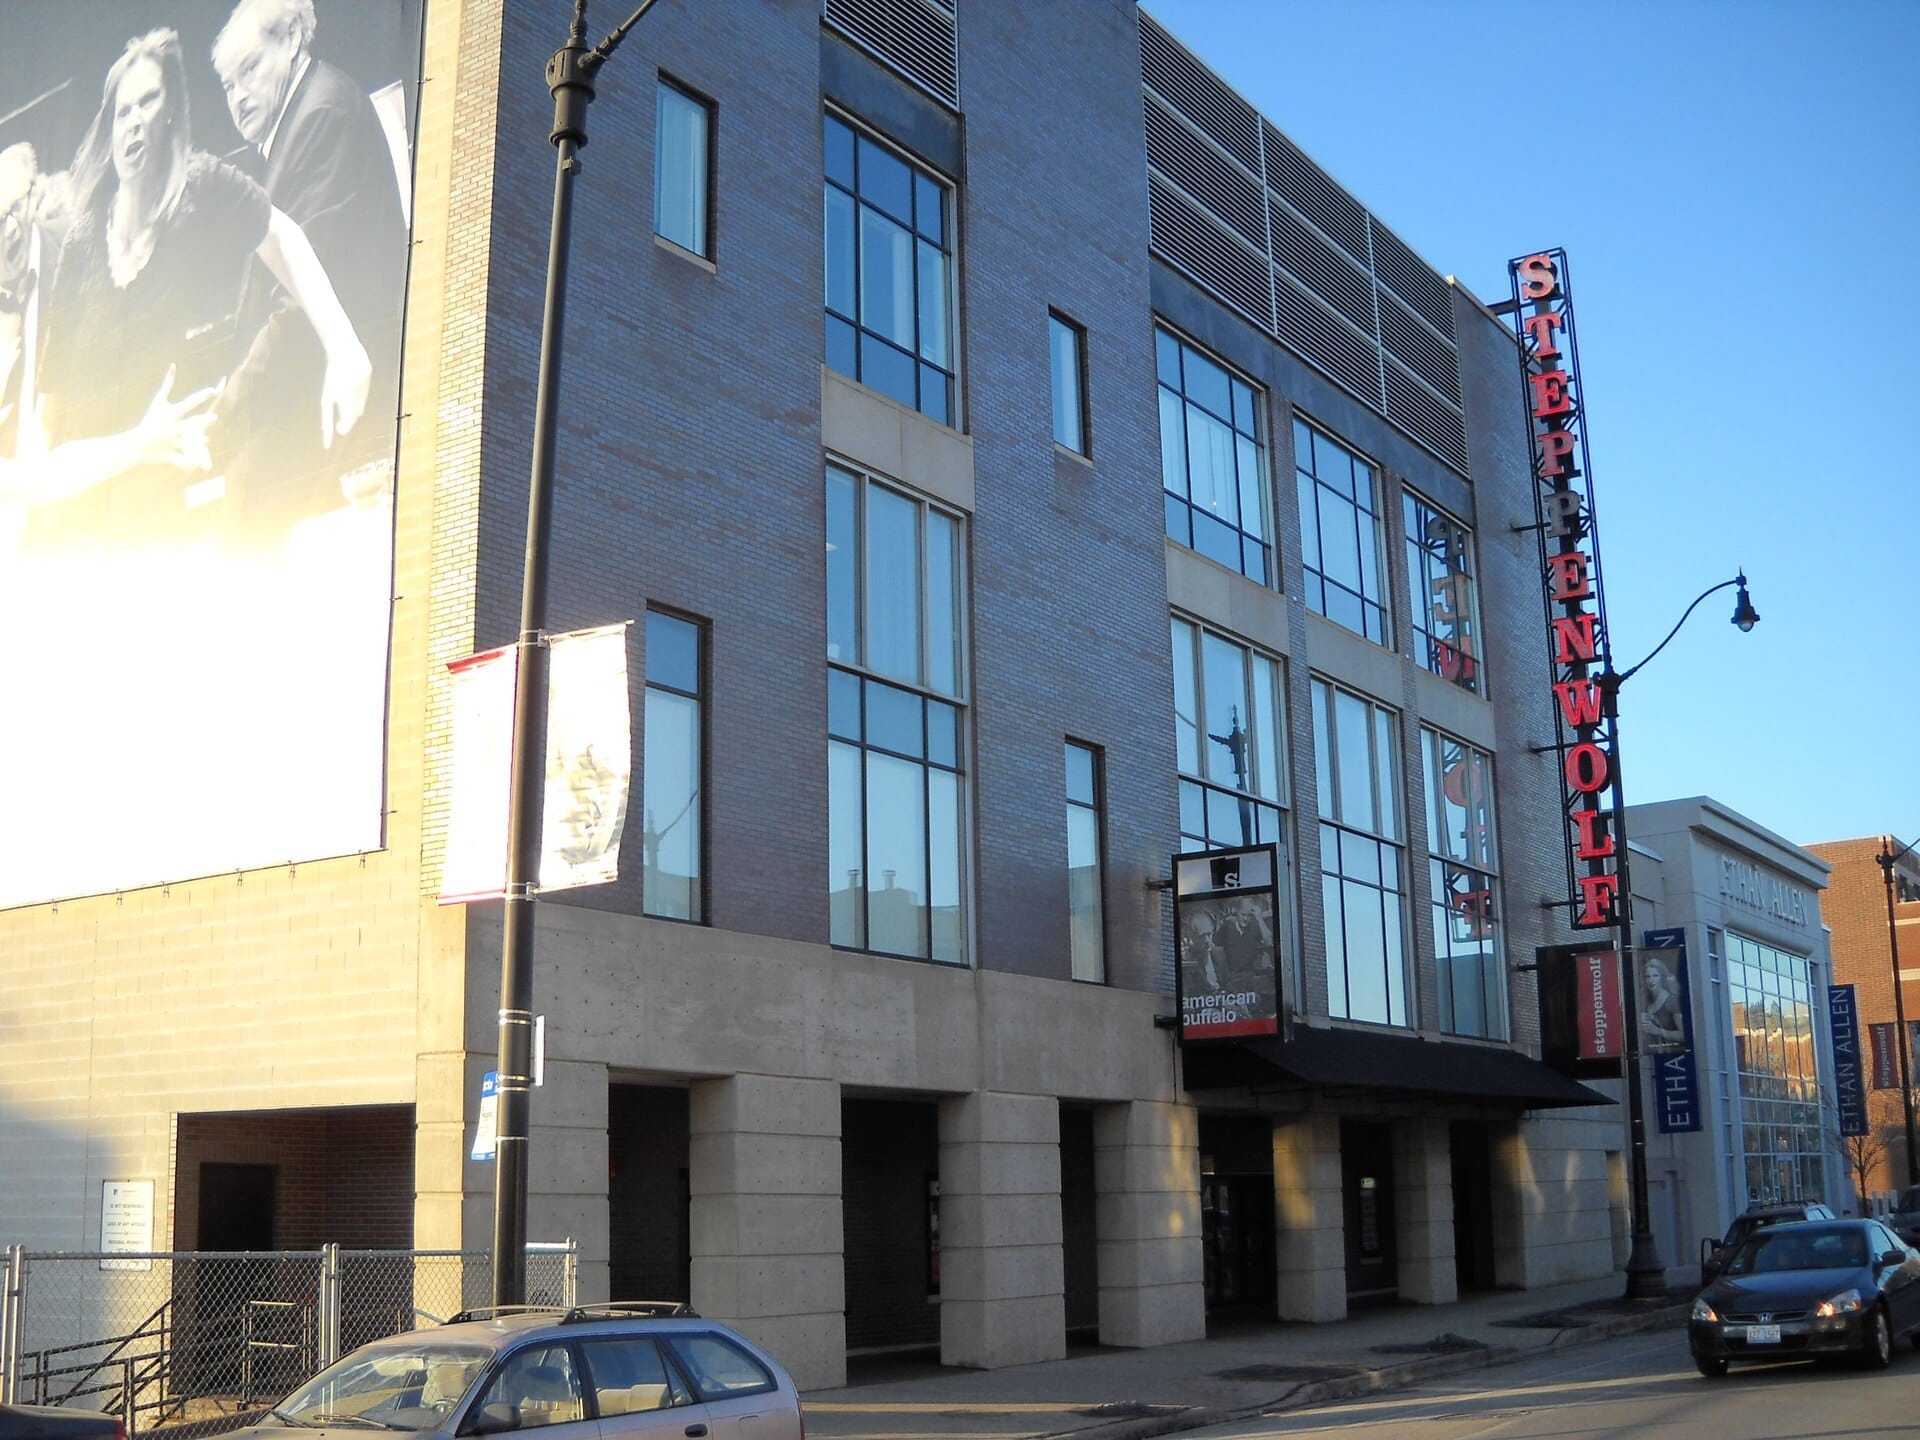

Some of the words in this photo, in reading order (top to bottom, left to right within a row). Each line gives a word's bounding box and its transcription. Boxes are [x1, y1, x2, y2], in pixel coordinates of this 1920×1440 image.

[1519, 254, 1618, 926] STEPPENWOLF
[1719, 856, 1764, 909] ETHAN
[1769, 879, 1808, 927] ALLEN
[1183, 990, 1256, 1009] american
[1590, 957, 1607, 1054] steppenwolf
[1831, 988, 1853, 1053] ALLEN
[1664, 1054, 1690, 1126] ETHA
[1838, 1063, 1860, 1132] ETHAN
